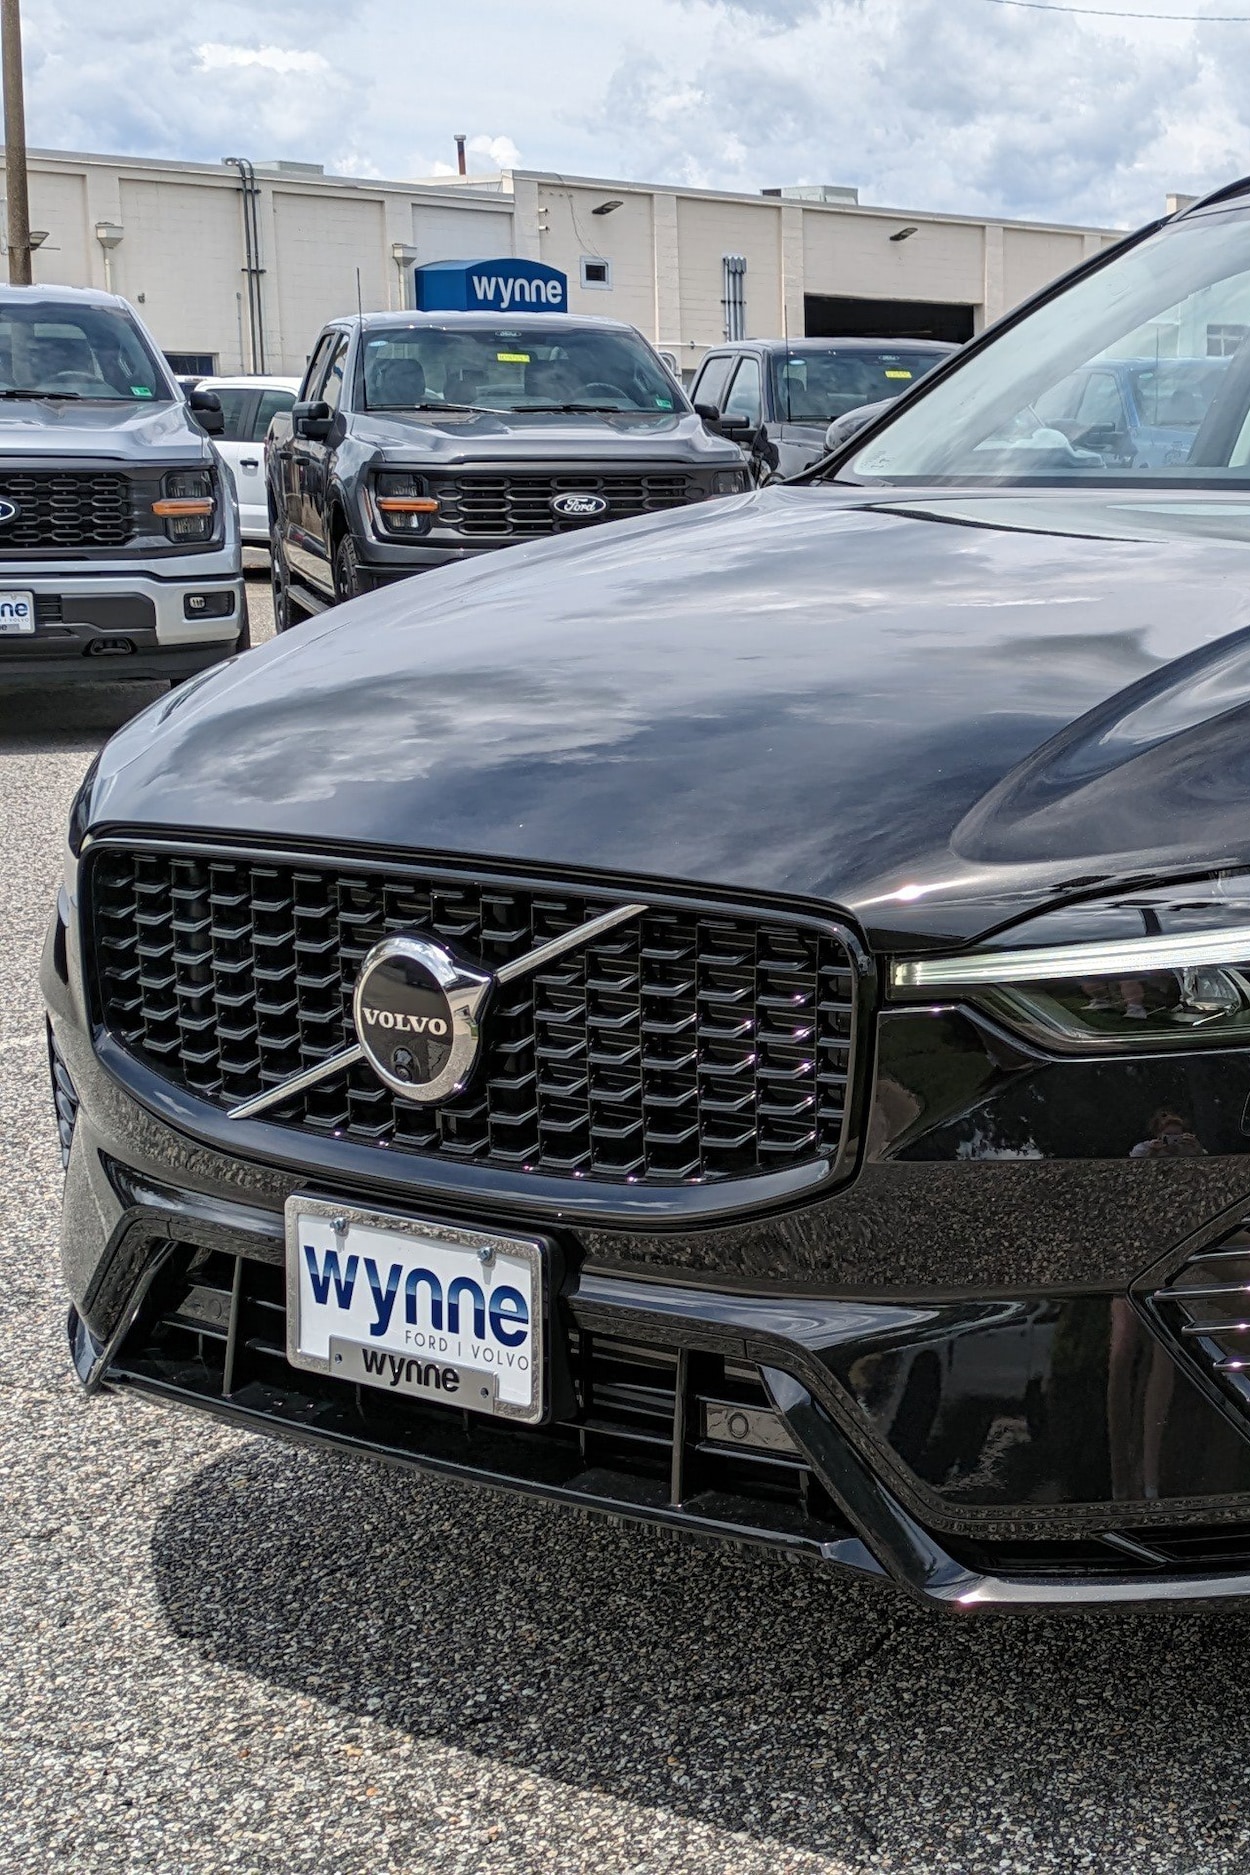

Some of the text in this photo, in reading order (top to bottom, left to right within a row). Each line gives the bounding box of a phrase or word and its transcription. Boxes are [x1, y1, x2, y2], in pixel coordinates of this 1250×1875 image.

[472, 275, 562, 310] wynne
[564, 498, 596, 512] Ford
[362, 1007, 448, 1035] VOLVO
[303, 1245, 529, 1347] wynne
[405, 1330, 448, 1352] FORD
[471, 1344, 529, 1371] VOLVO
[362, 1348, 460, 1393] wynne
